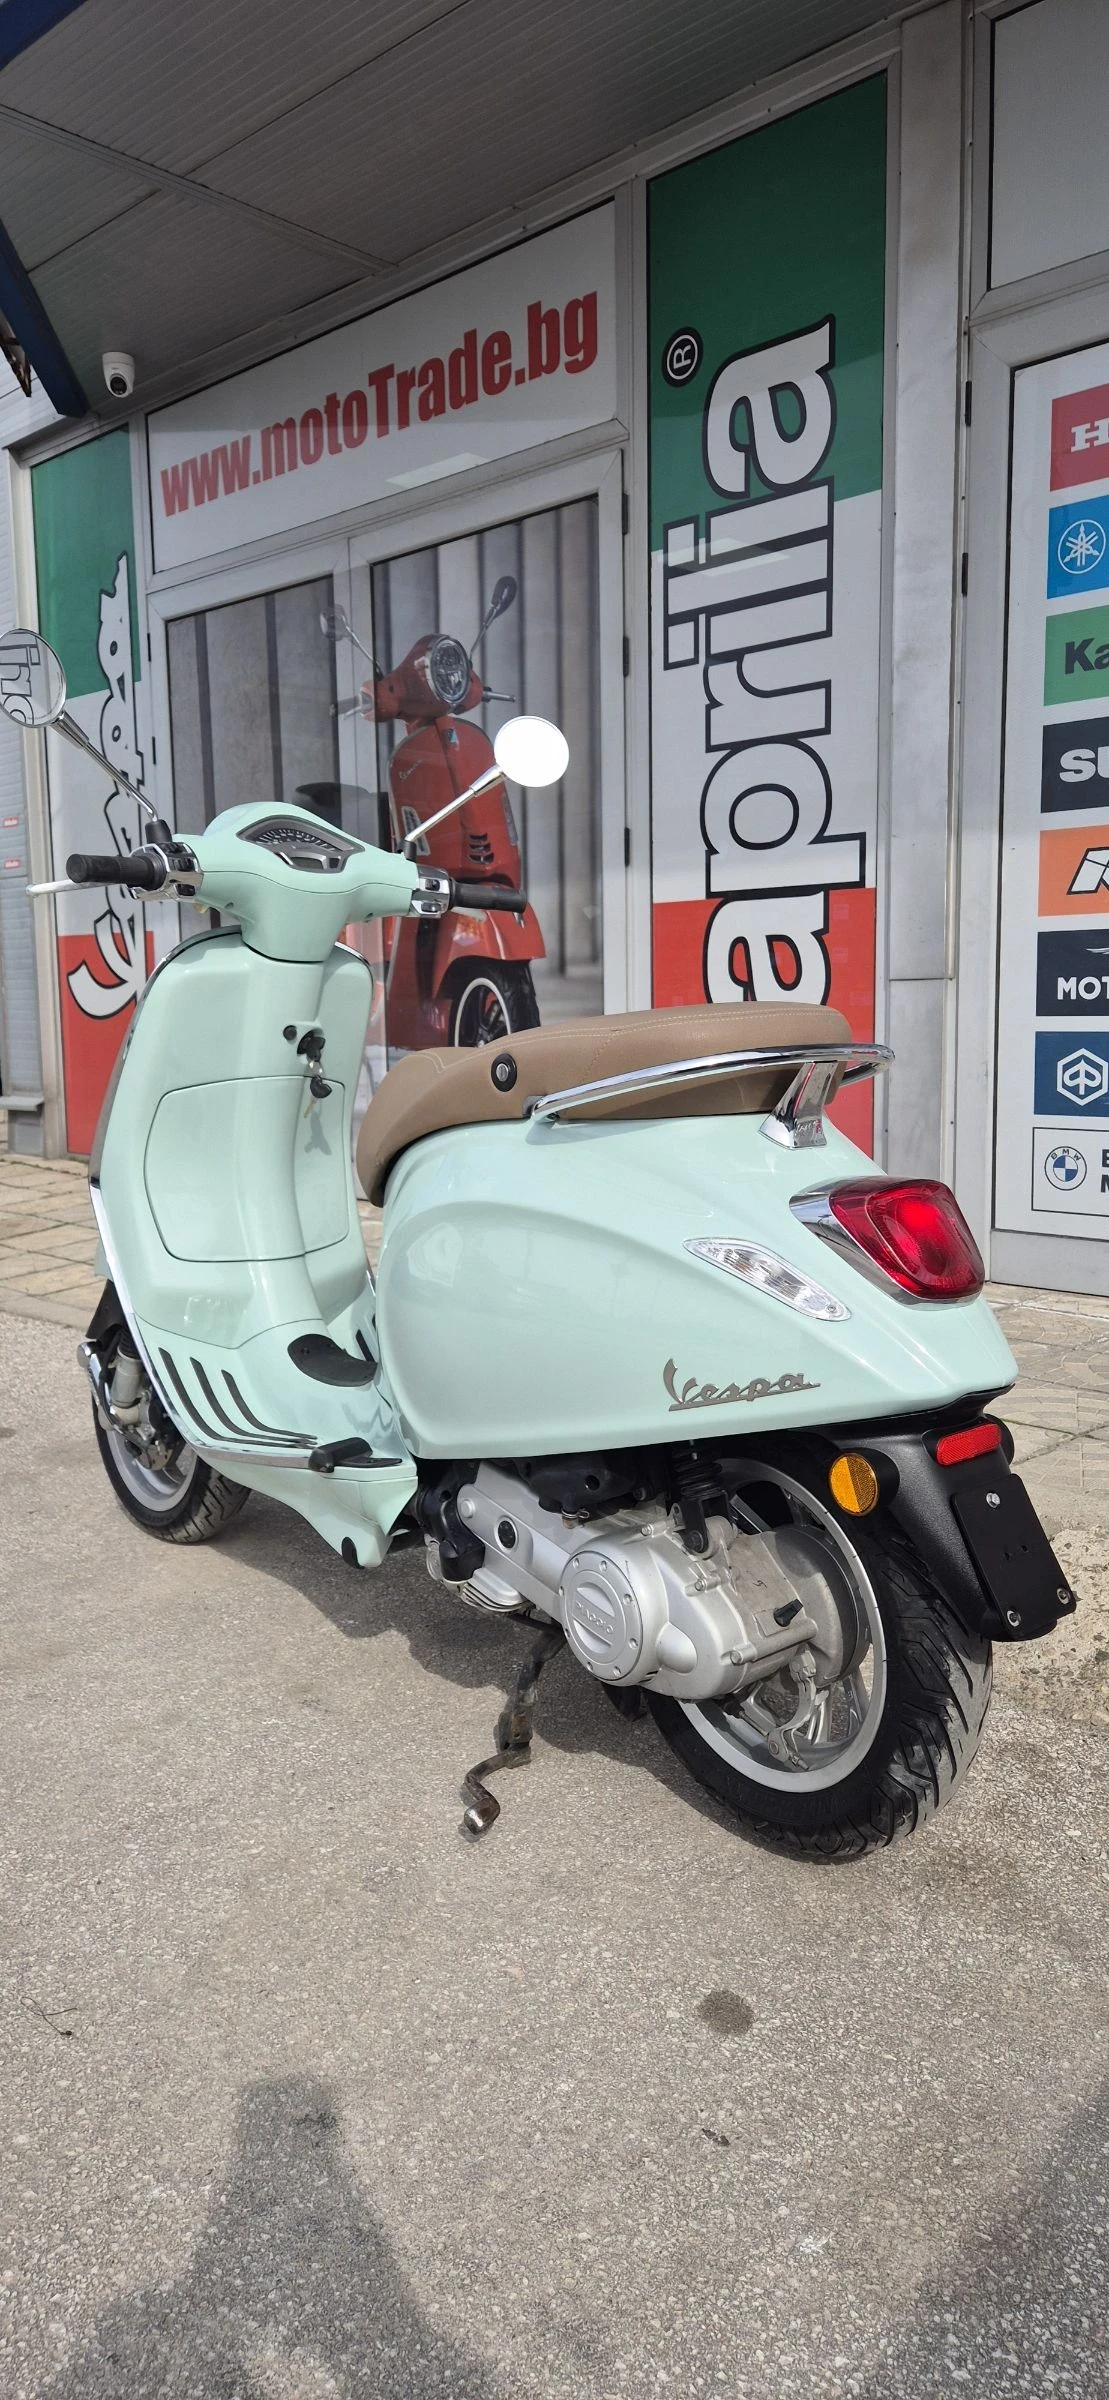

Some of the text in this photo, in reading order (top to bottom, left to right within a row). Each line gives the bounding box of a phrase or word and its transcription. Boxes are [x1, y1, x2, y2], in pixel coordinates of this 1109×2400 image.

[160, 291, 598, 517] www.motoTrade.bg
[664, 313, 867, 1004] aprilia
[662, 1358, 821, 1412] Vespa
